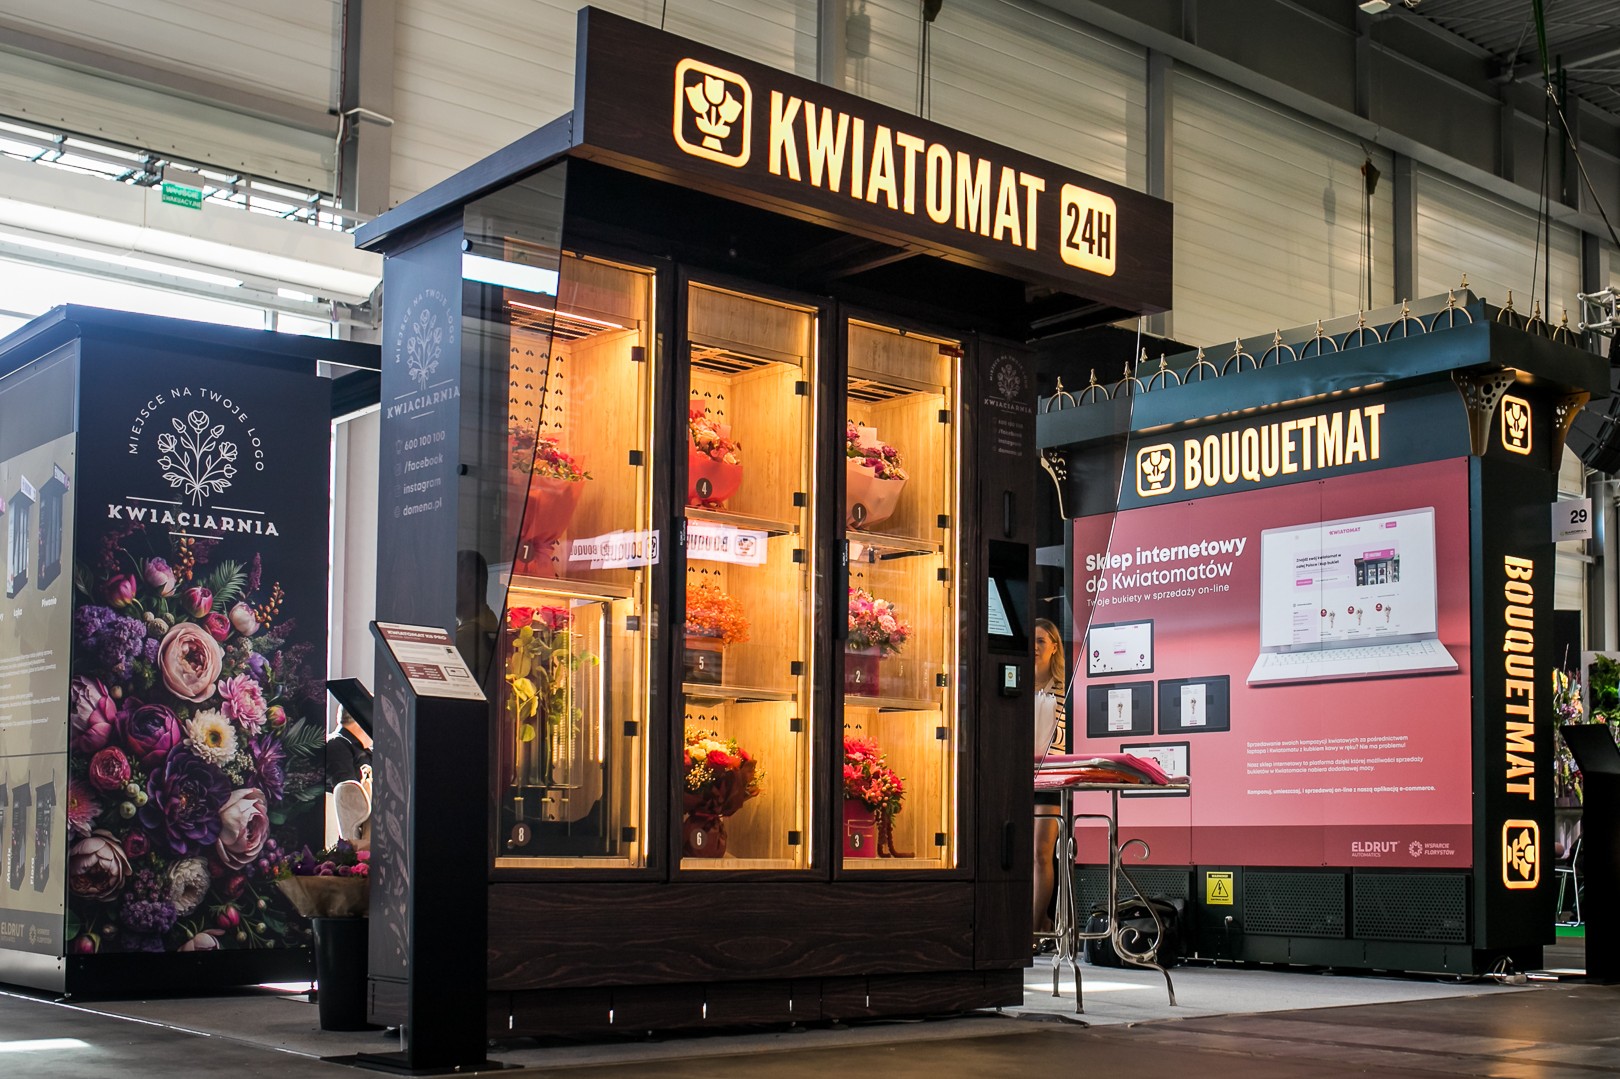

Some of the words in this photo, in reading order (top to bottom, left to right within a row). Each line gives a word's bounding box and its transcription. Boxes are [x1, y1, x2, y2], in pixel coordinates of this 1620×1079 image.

[768, 90, 1045, 251] KWIATOMAT
[1065, 201, 1112, 261] 24H
[386, 385, 461, 419] KWIACIARNIA
[129, 394, 166, 454] MIEJSCE
[171, 386, 192, 398] NA
[200, 388, 248, 423] TWOJE
[248, 428, 264, 471] LOGO
[404, 438, 418, 451] 600
[419, 434, 432, 447] 100
[432, 430, 446, 443] 100
[1183, 403, 1386, 491] BOUQUETMAT
[404, 453, 444, 474] /facebook
[403, 478, 442, 494] instagram
[701, 482, 708, 495] 4
[402, 497, 442, 516] domena.pl
[1570, 508, 1588, 524] 29
[107, 504, 280, 537] KWIACIARNIA
[523, 546, 529, 560] 7
[1086, 552, 1132, 572] Sklep
[1136, 536, 1247, 565] internetowy
[1086, 574, 1108, 593] do
[1112, 560, 1233, 590] Kwiatomatów
[1087, 597, 1110, 607] Twoje
[1112, 593, 1142, 604] bukiety
[1152, 587, 1196, 600] sprzedaży
[1198, 584, 1230, 595] on-line
[699, 656, 704, 670] 5
[856, 670, 861, 683] 2
[1503, 555, 1535, 800] BOUQUETMAT
[518, 827, 524, 842] 8
[696, 832, 702, 846] 6
[854, 834, 860, 848] 3
[1352, 842, 1398, 852] ELDRUT
[1, 922, 24, 937] ELDRUT
